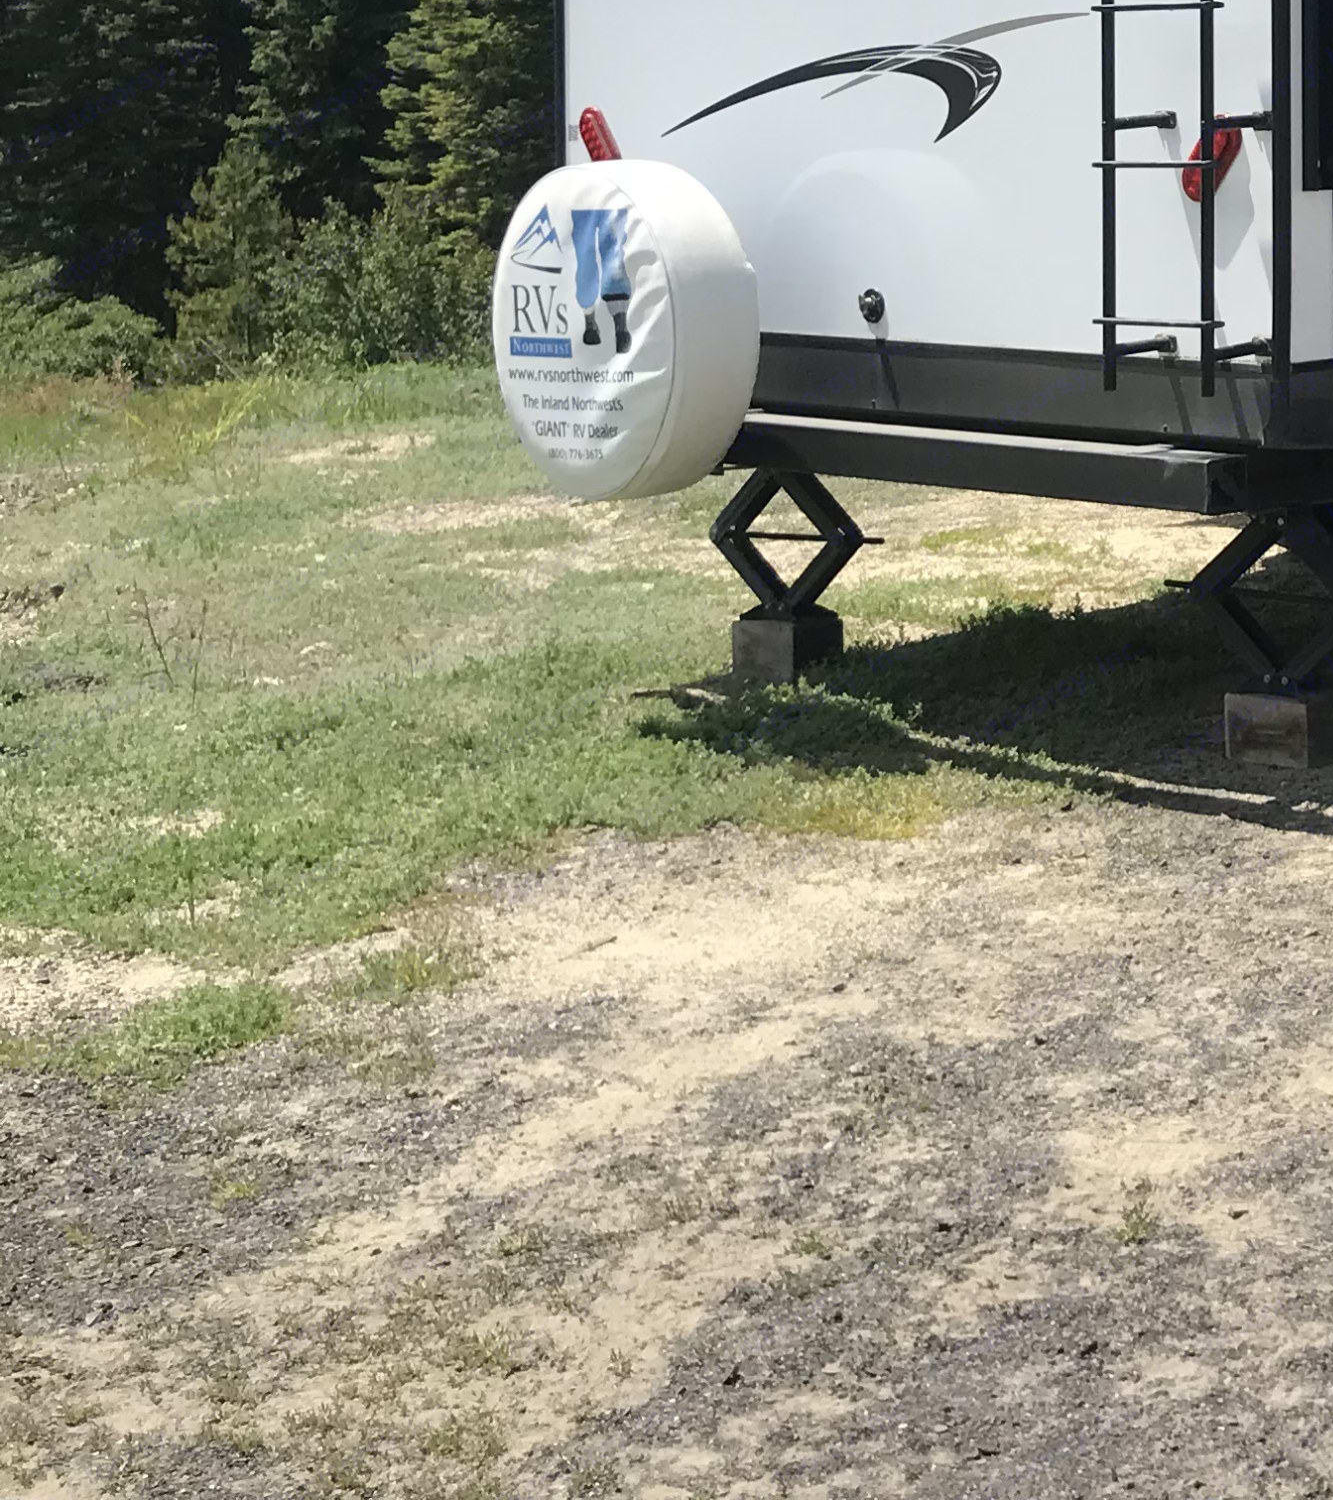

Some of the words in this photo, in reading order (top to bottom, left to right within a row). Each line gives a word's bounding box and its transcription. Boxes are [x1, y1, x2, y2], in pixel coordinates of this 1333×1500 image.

[508, 366, 635, 384] www.rvsnorthwest.com
[522, 394, 539, 410] The
[541, 394, 570, 411] Inland
[573, 424, 586, 439] RV
[588, 422, 619, 439] Dealer
